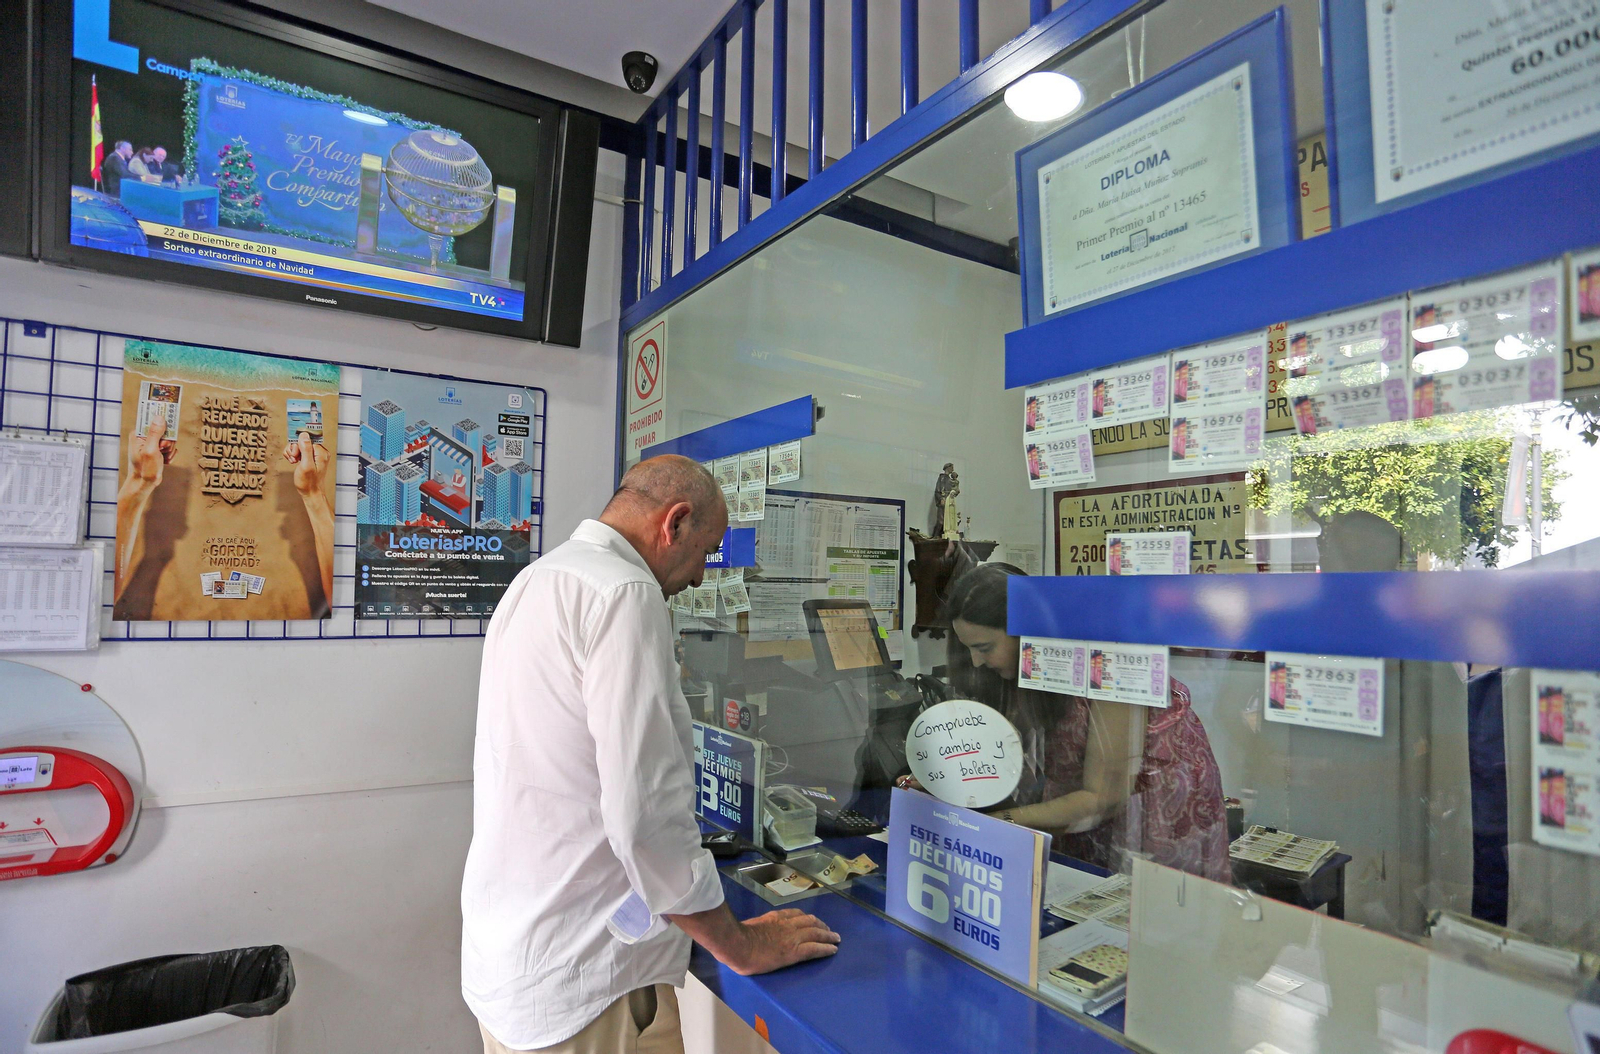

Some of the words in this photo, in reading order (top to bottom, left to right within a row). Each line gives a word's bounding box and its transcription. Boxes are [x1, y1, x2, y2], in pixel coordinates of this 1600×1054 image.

[146, 57, 220, 87] Campañ
[1116, 135, 1147, 153] APUESTAS
[1147, 130, 1159, 139] DEL
[1160, 116, 1186, 133] ESTADO
[300, 135, 362, 174] Mayo
[291, 154, 362, 187] Premio
[1100, 149, 1171, 191] DIPLOMA
[267, 170, 386, 211] Comparti
[1072, 213, 1078, 221] a
[1120, 185, 1142, 202] Luisa
[1142, 174, 1169, 190] Muñoz
[1076, 232, 1107, 251] Primer
[1109, 217, 1144, 239] Premio
[1146, 210, 1156, 225] al
[1173, 190, 1207, 213] 13465
[163, 227, 175, 237] 22
[178, 230, 189, 240] de
[192, 232, 241, 249] Diciembre
[243, 242, 254, 252] de
[256, 244, 277, 256] 2018
[1149, 222, 1188, 243] Nacional
[163, 240, 196, 255] Sorteo
[198, 248, 263, 267] extraordinario
[265, 259, 277, 269] de
[278, 262, 314, 276] Navidad
[305, 294, 338, 305] Panasonic
[469, 292, 497, 307] TV4
[1459, 287, 1526, 313] 03037
[1326, 318, 1379, 339] 13367
[1204, 353, 1246, 369] 16976
[1117, 372, 1152, 387] 13366
[1459, 365, 1525, 387] 03037
[1046, 389, 1077, 403] 16205
[1330, 387, 1381, 402] 13367
[201, 409, 269, 429] RECUERDO
[629, 409, 663, 434] PROHIBIDO
[1202, 414, 1244, 428] 16976
[200, 425, 268, 448] QUIERES
[634, 431, 656, 450] FUMAR
[1092, 424, 1125, 446] ENDO
[1130, 422, 1148, 441] LA
[201, 442, 267, 461] LLEVARTE
[1047, 439, 1078, 452] 16205
[221, 459, 247, 472] ESTE
[200, 471, 266, 489] VERANO?
[1061, 516, 1074, 529] EN
[1079, 513, 1107, 528] ESTA
[1113, 506, 1216, 526] ADMINISTRACION
[225, 537, 238, 545] CAE
[389, 532, 503, 553] LoteríasPRO
[1135, 540, 1171, 551] 12559
[1190, 538, 1253, 560] ETAS
[209, 557, 261, 568] NAVIDAD?
[384, 550, 428, 559] Conéctate
[436, 552, 447, 560] tu
[448, 552, 468, 562] punto
[468, 552, 481, 561] de
[482, 553, 505, 562] venta
[1043, 647, 1073, 659] 07680
[1115, 654, 1150, 666] 11081
[1305, 668, 1356, 684] 27863
[914, 711, 987, 740] Compruebe
[703, 748, 715, 761] STE
[717, 754, 742, 771] JUEVES
[916, 750, 928, 761] su
[939, 740, 982, 756] cambio
[993, 740, 1005, 759] y
[928, 770, 945, 782] sus
[960, 760, 998, 777] boletos
[720, 804, 741, 824] EUROS
[958, 819, 980, 832] Nacional
[910, 824, 940, 846] ESTE
[943, 834, 1004, 870] SÁBADO
[909, 837, 1003, 892] DÉCIMOS
[906, 860, 1002, 927] 6,00
[953, 917, 1000, 951] EUROS
